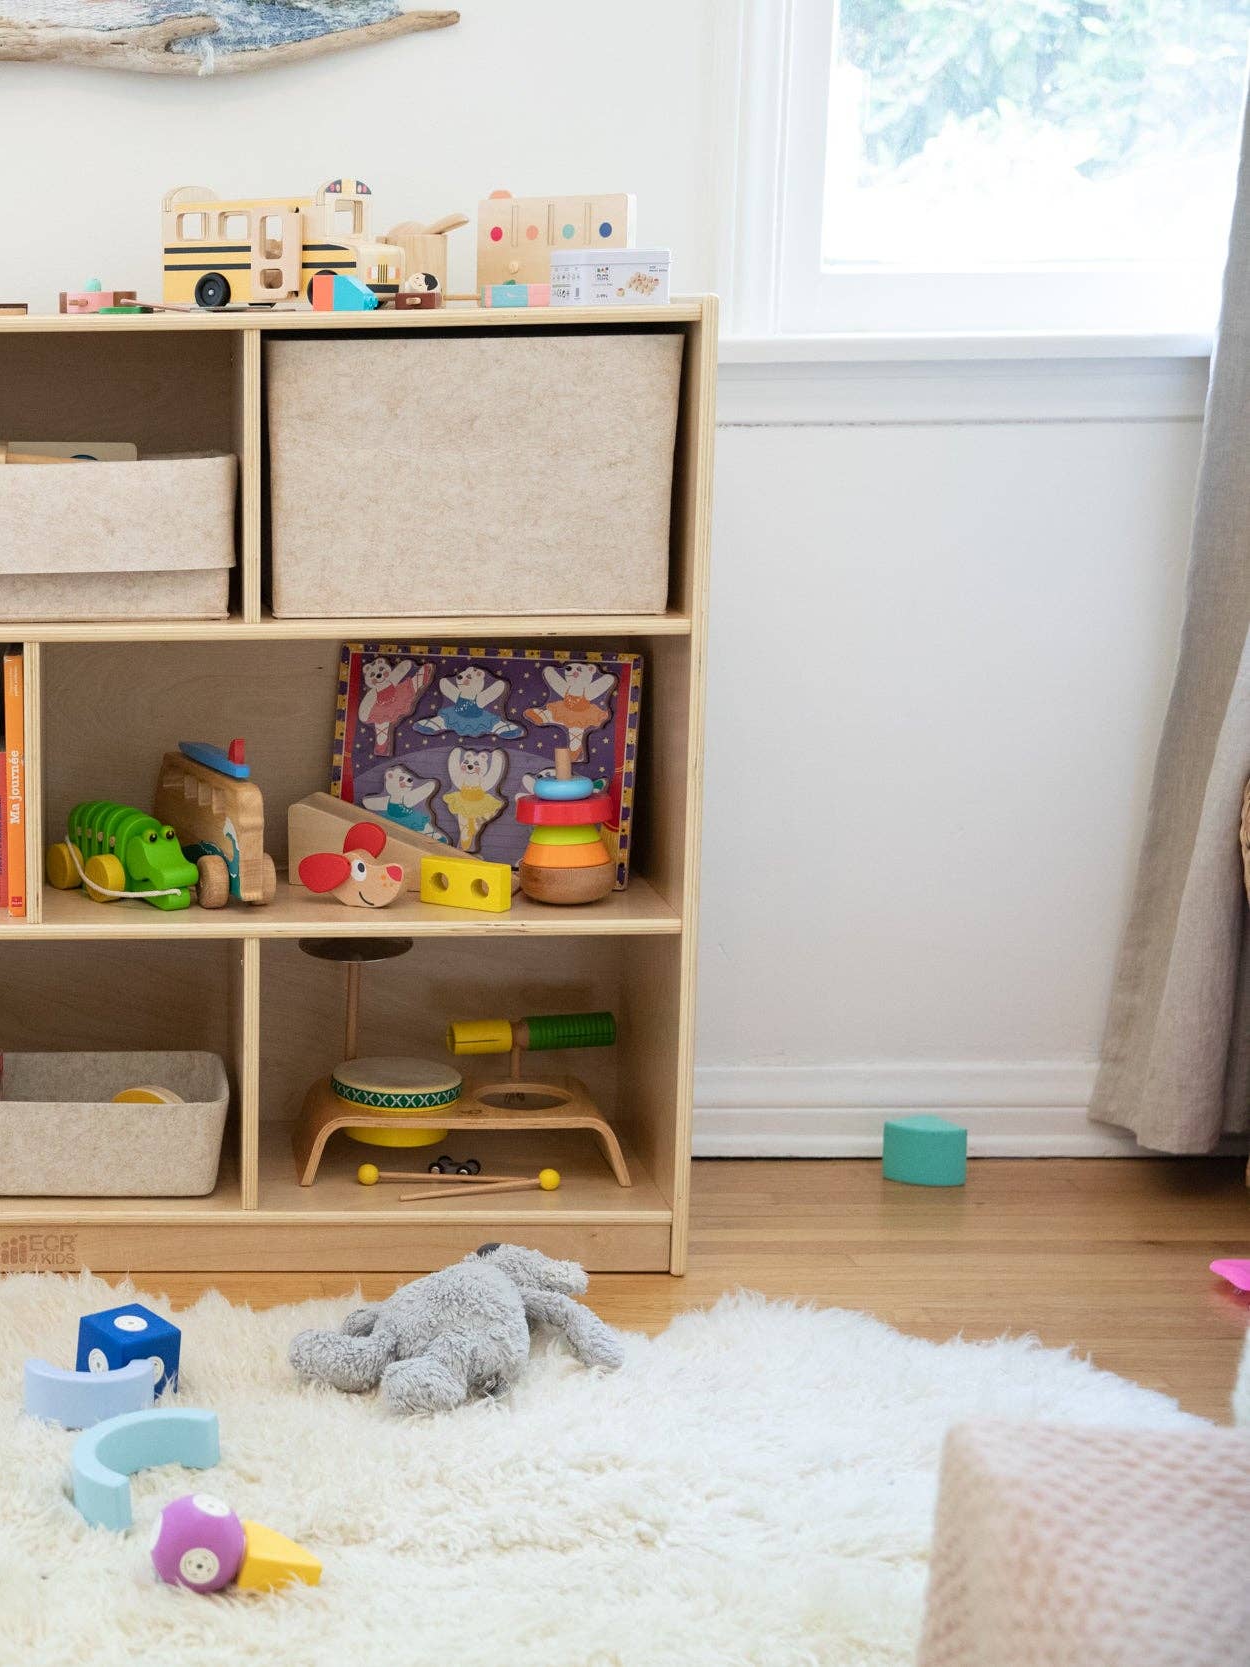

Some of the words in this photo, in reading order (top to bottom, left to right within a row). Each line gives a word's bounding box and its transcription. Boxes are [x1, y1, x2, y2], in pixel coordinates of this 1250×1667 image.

[9, 750, 22, 801] journée
[10, 803, 20, 825] Ma
[29, 1234, 75, 1252] ECR
[41, 1252, 76, 1265] KIDS
